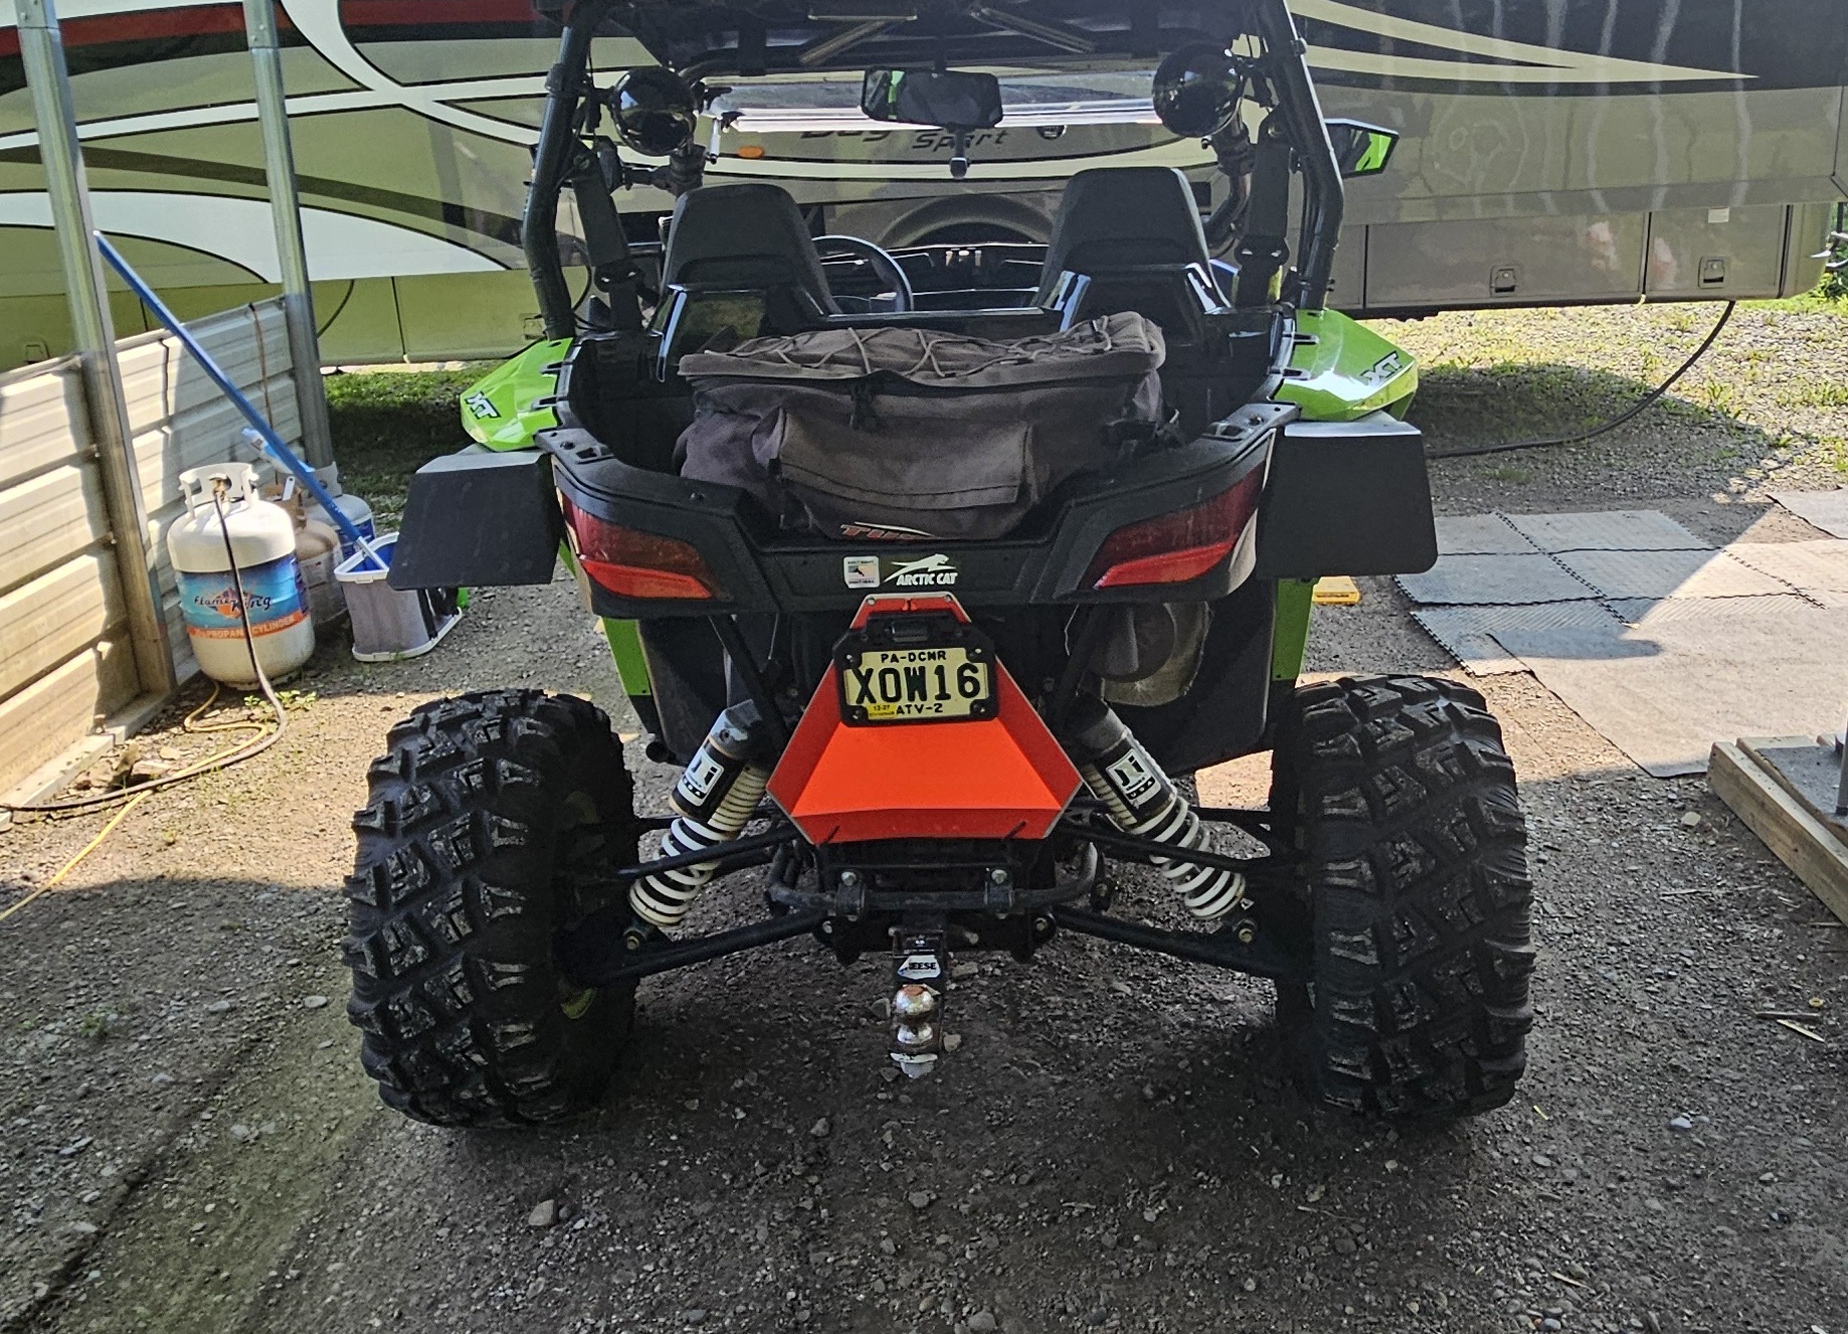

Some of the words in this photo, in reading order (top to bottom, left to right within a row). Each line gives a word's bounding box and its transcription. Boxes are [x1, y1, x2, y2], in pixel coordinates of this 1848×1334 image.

[912, 130, 1008, 152] Sprt
[464, 391, 502, 420] XT
[896, 573, 935, 586] ARCTIC
[936, 572, 958, 585] CAT
[230, 595, 272, 611] Kng
[206, 628, 245, 639] PROPAN
[880, 651, 946, 663] PA-DCNR
[852, 663, 981, 704] XOW16
[897, 703, 943, 715] ATV-2
